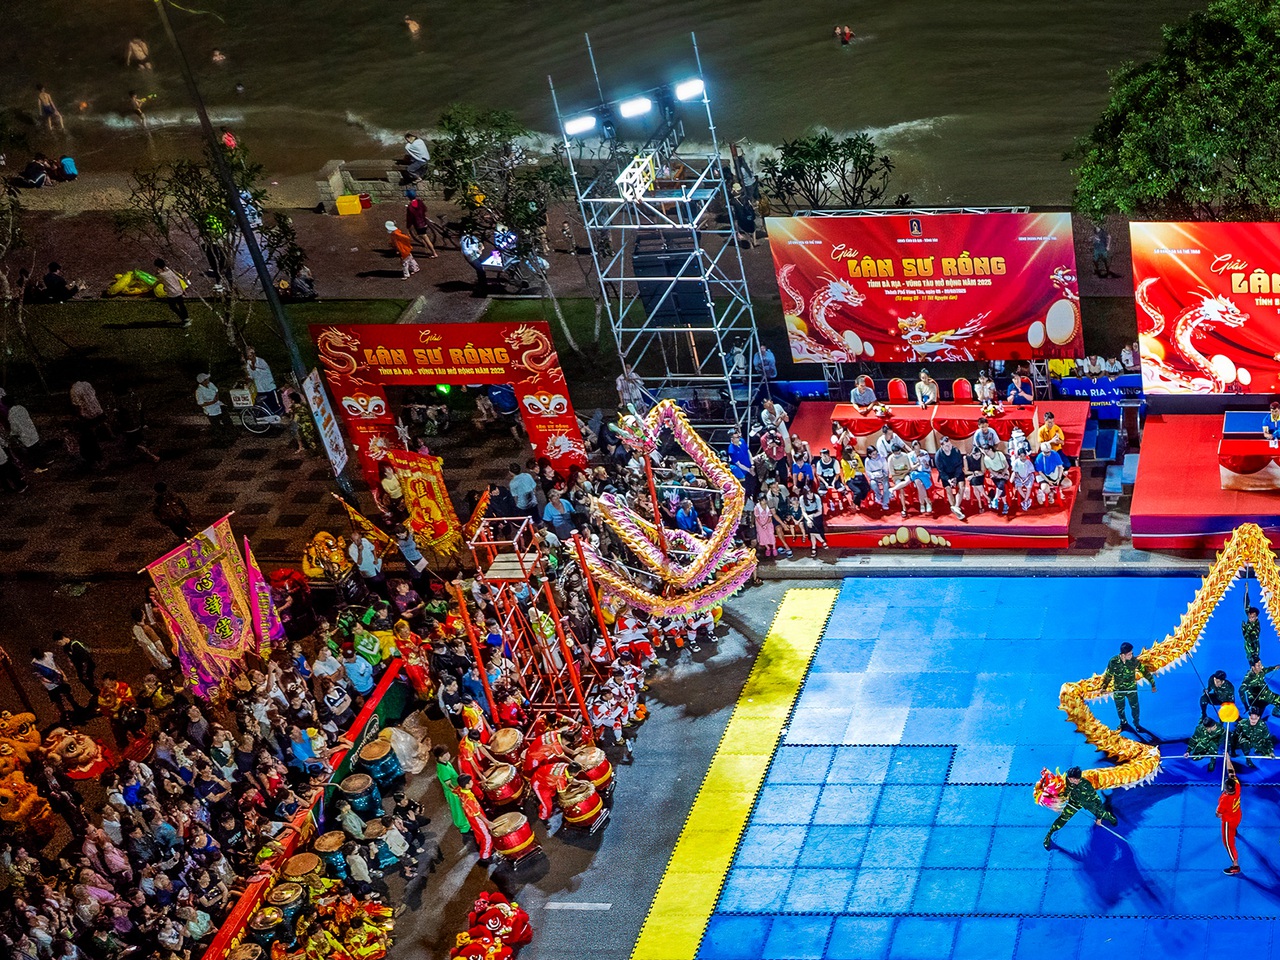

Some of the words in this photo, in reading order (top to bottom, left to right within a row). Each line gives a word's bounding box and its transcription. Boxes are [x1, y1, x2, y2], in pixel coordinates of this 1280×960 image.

[847, 255, 894, 278] LÂN
[902, 256, 934, 277] SƯ
[941, 250, 1006, 276] RỒNG
[1210, 253, 1248, 275] Giải
[1255, 296, 1273, 305] TỈNH
[364, 345, 408, 365] LÂN
[413, 346, 443, 365] SƯ
[449, 342, 510, 364] RỒNG
